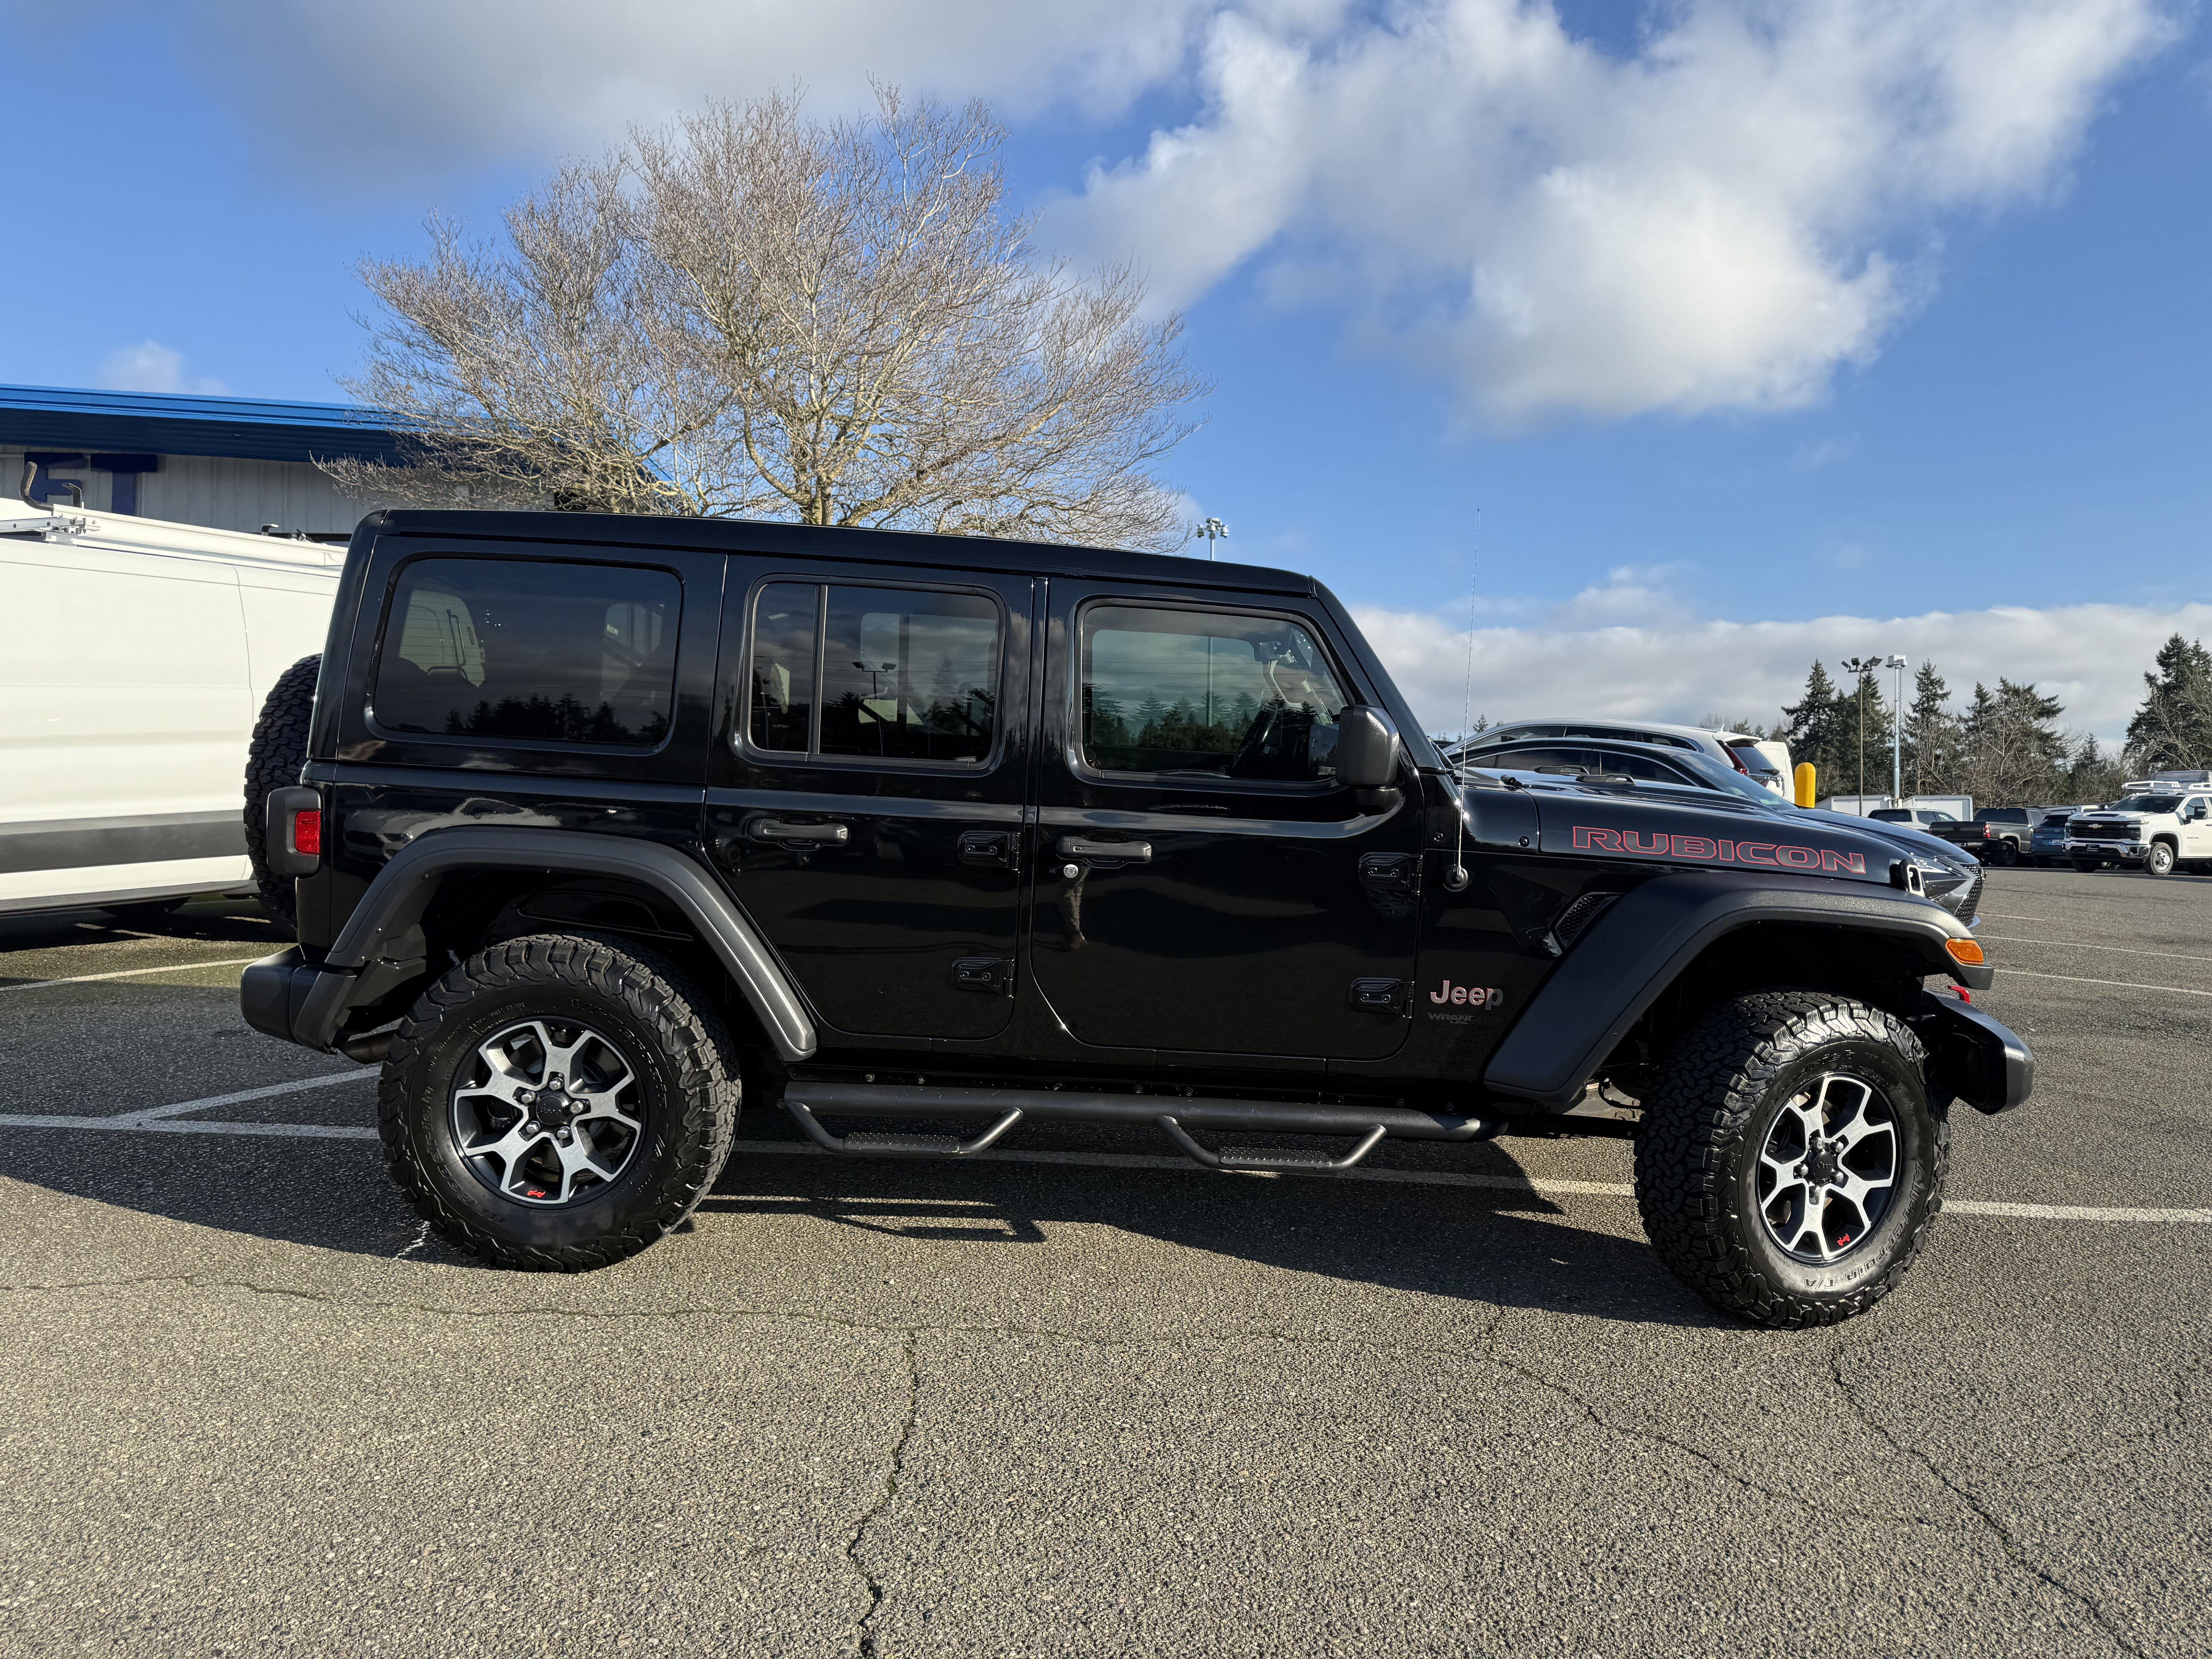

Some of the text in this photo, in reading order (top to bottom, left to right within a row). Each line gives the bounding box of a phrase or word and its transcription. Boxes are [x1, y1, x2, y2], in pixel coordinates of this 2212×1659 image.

[1573, 826, 1867, 874] RUBICON
[1430, 980, 1503, 1010] Jeep
[1427, 1012, 1484, 1022] WRAN
[1804, 1277, 1839, 1290] T/A
